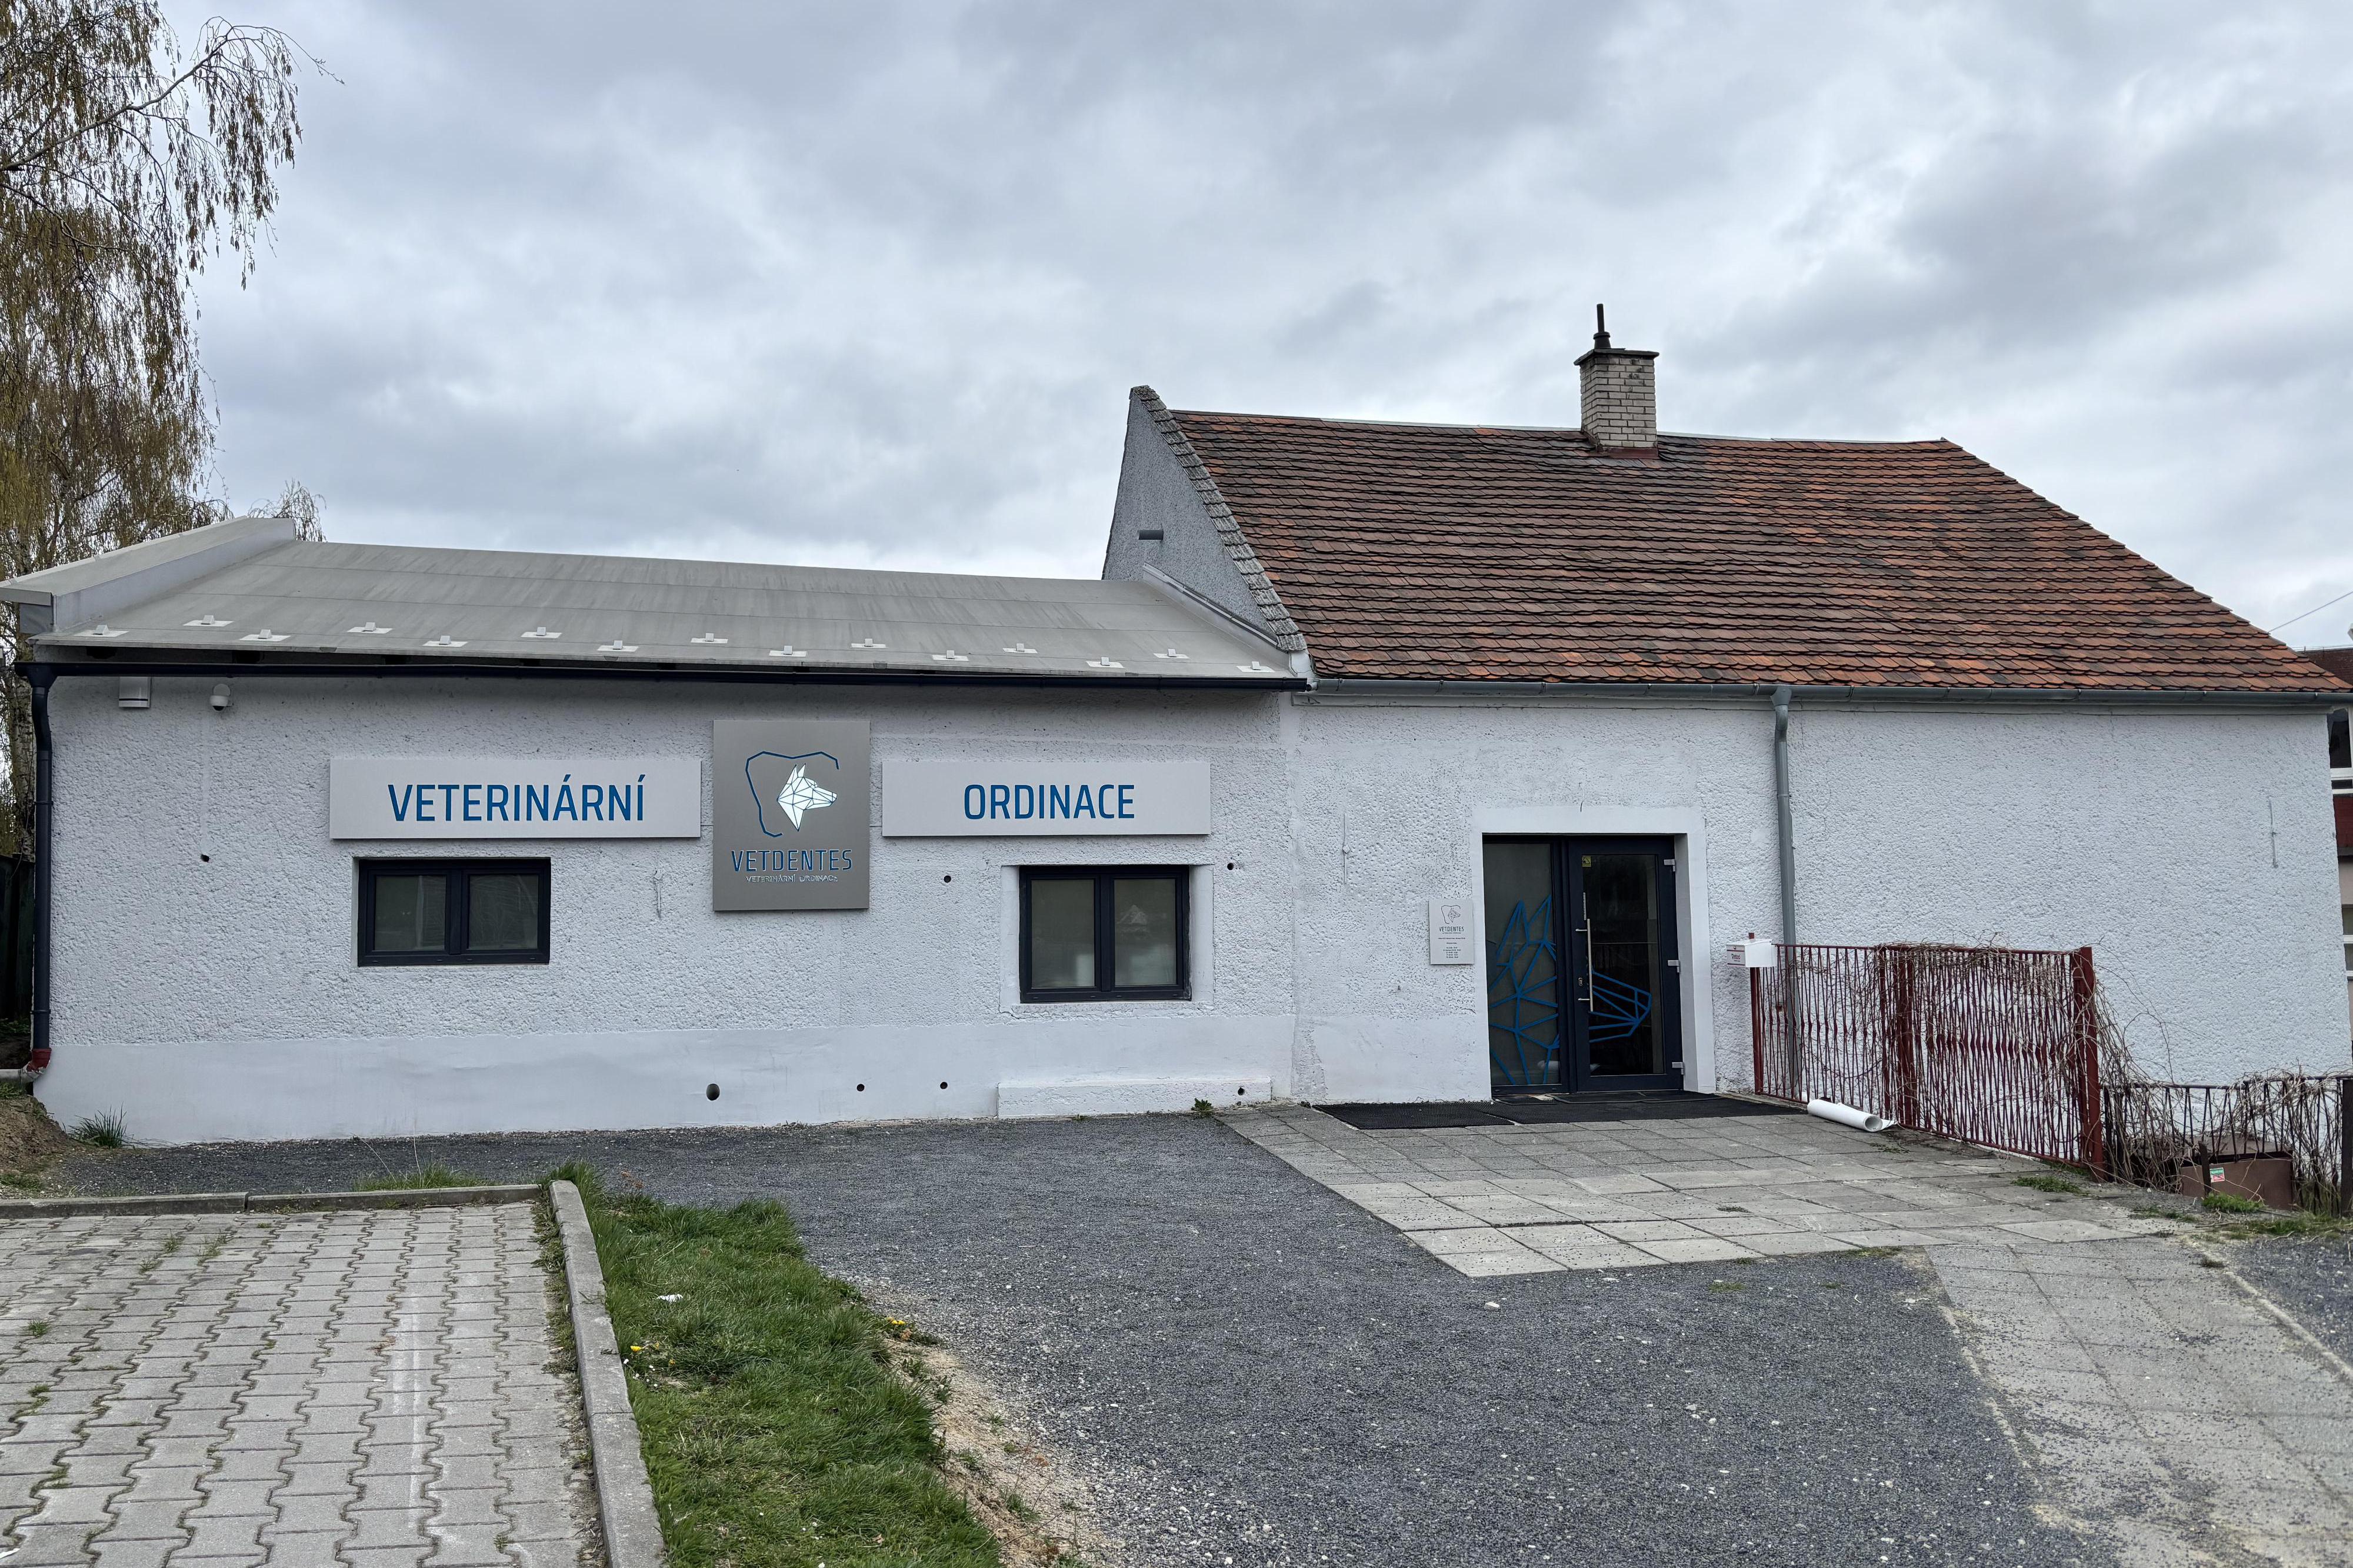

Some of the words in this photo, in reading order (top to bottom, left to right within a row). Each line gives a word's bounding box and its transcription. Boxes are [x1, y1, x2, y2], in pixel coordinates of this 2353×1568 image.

[388, 774, 645, 822] VETERINÁRNÍ
[964, 784, 1135, 820] ORDINACE
[731, 849, 852, 872] VETDENTES
[746, 874, 796, 882] VETERINÁRNÍ
